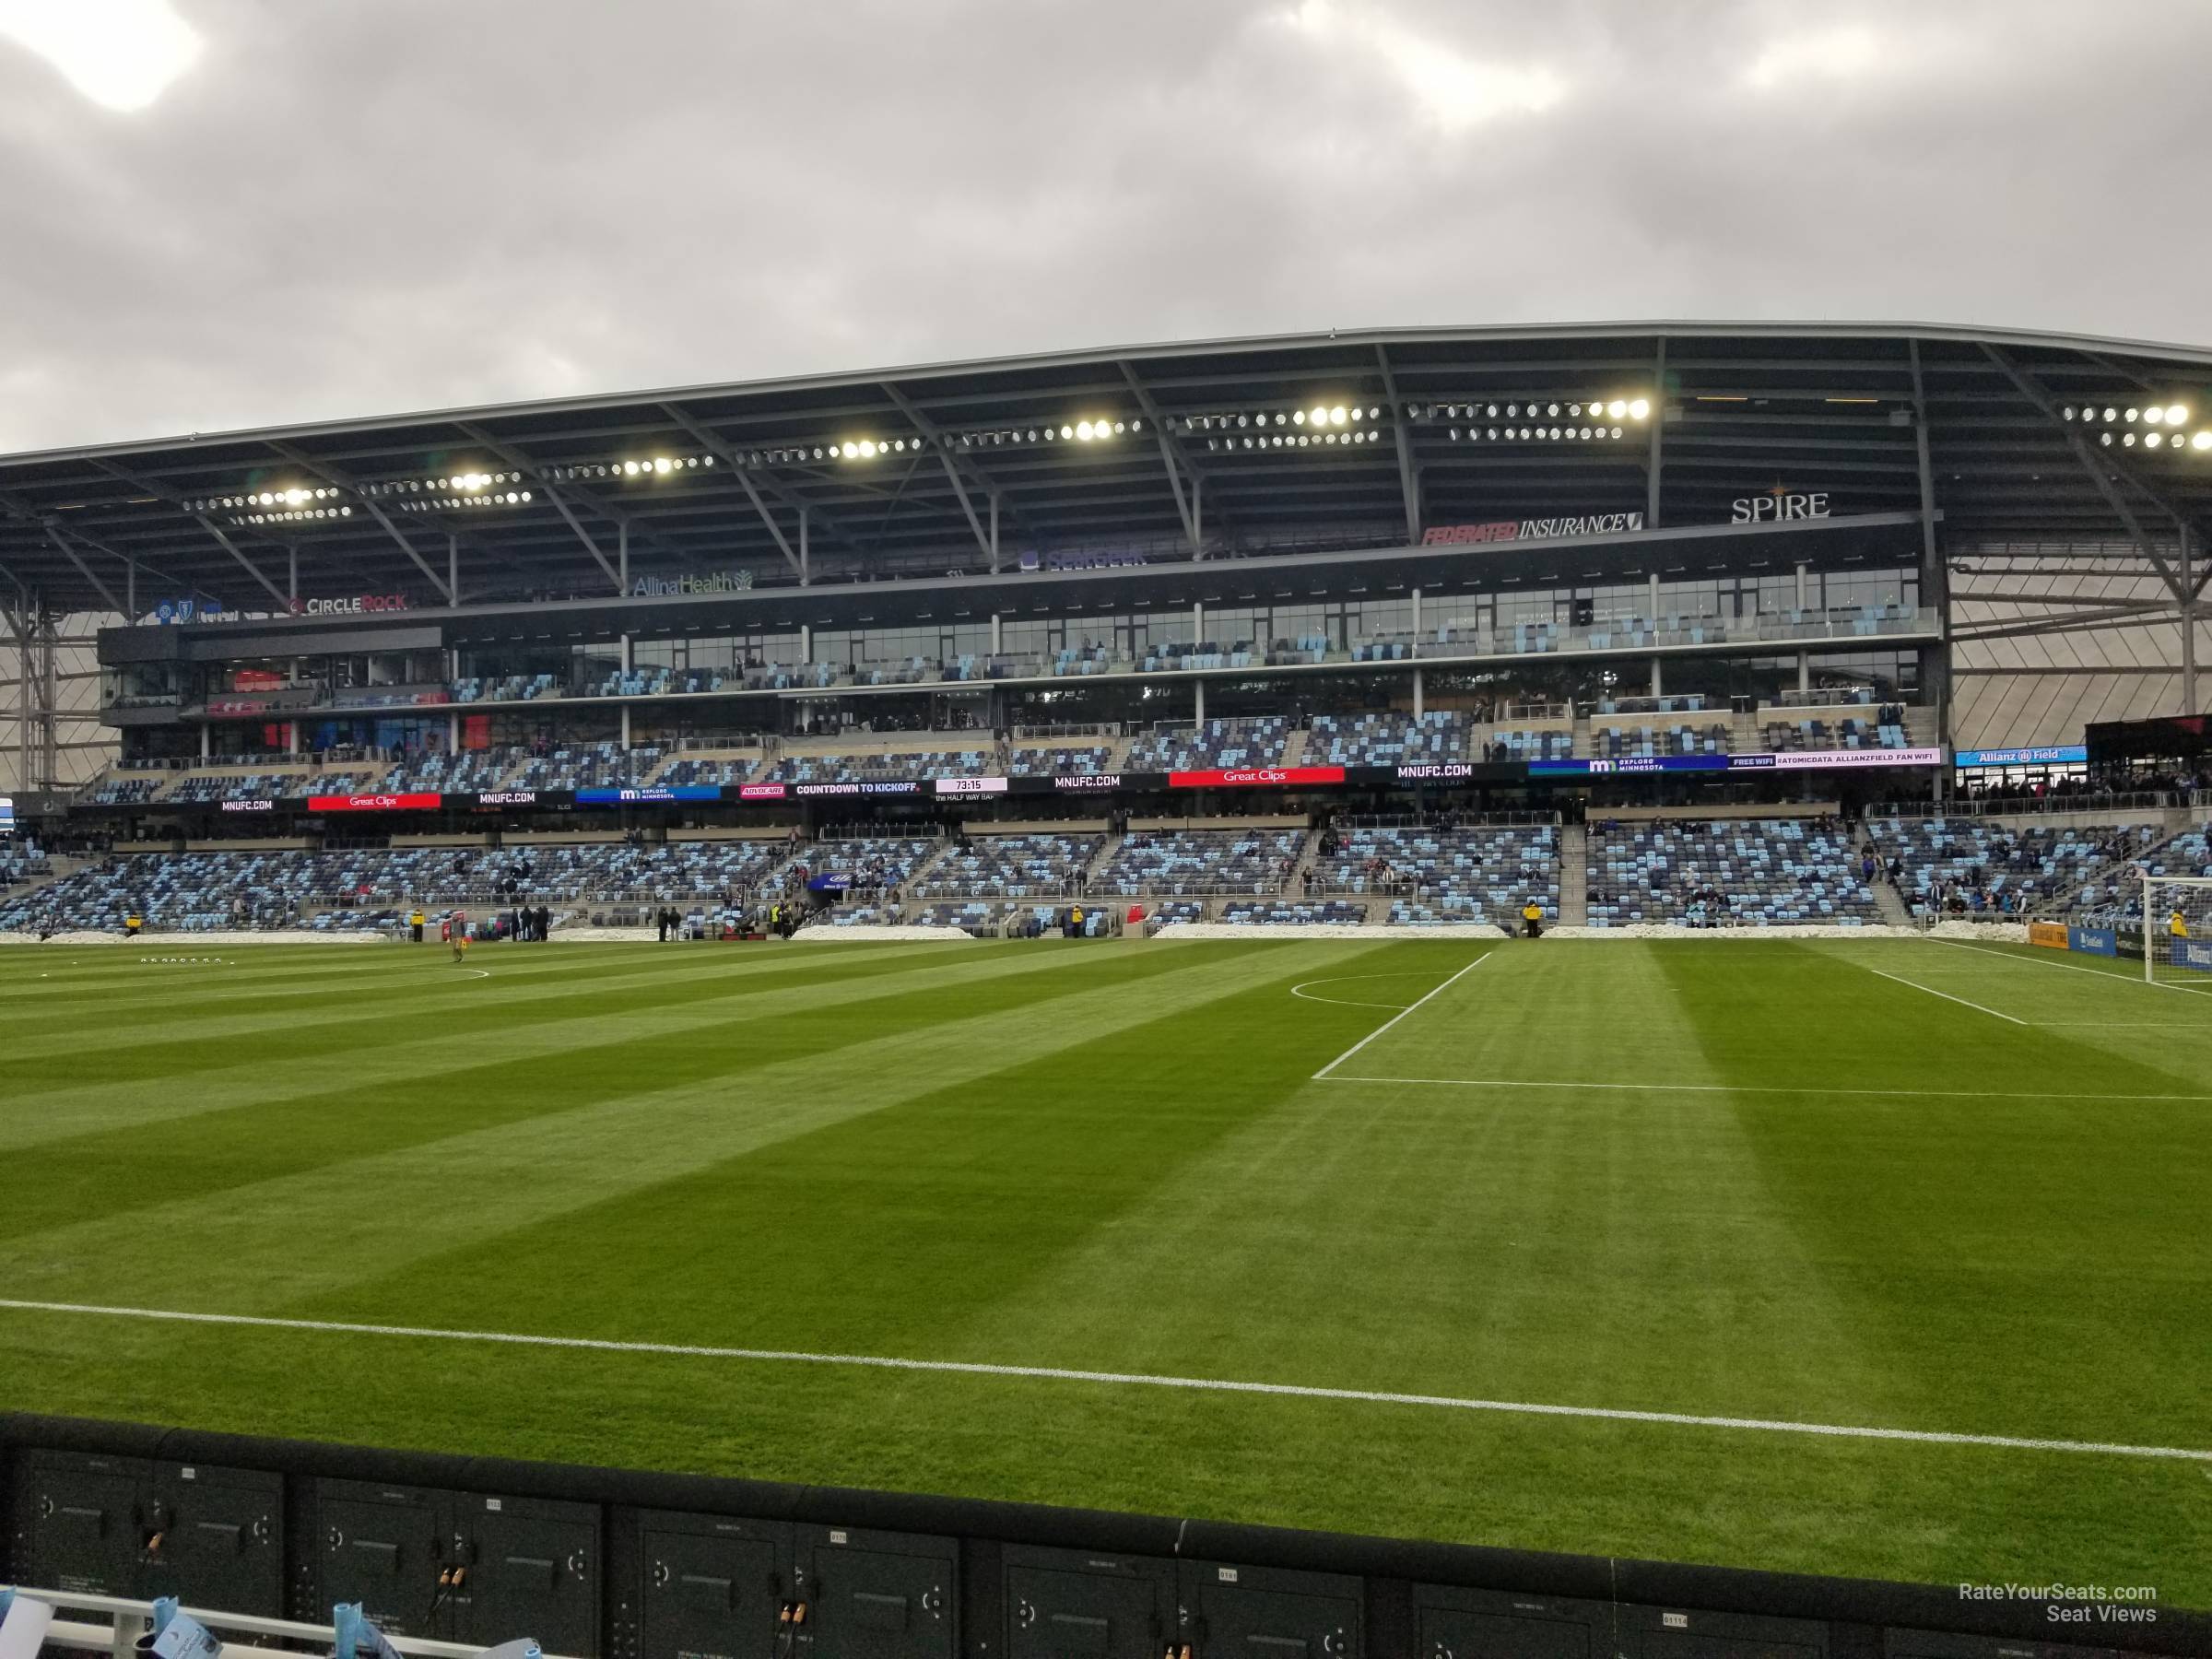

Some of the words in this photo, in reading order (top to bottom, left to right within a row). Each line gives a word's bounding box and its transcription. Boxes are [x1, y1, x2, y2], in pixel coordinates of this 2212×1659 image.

[1732, 492, 1830, 524] SPIRE
[1421, 522, 1518, 546] FEDERATED
[1519, 513, 1626, 539] INSURANCE
[1836, 754, 1893, 762] ALLIANZFIELD
[1979, 752, 2016, 762] Allianz
[2033, 749, 2058, 759] Field
[1224, 771, 1255, 782] Great
[1258, 771, 1286, 782] Clips
[1397, 765, 1472, 778] MNUFC.COM
[956, 781, 982, 790] 73:15
[1055, 776, 1120, 788] MNUFC.COM
[741, 786, 783, 795] ADVOCARE
[796, 784, 859, 794] COUNTDOWN
[860, 783, 874, 793] TO
[349, 797, 374, 806] Great
[375, 796, 396, 807] Clips
[479, 793, 535, 804] MNUFC.COM
[222, 800, 272, 811] MNUFC.COM
